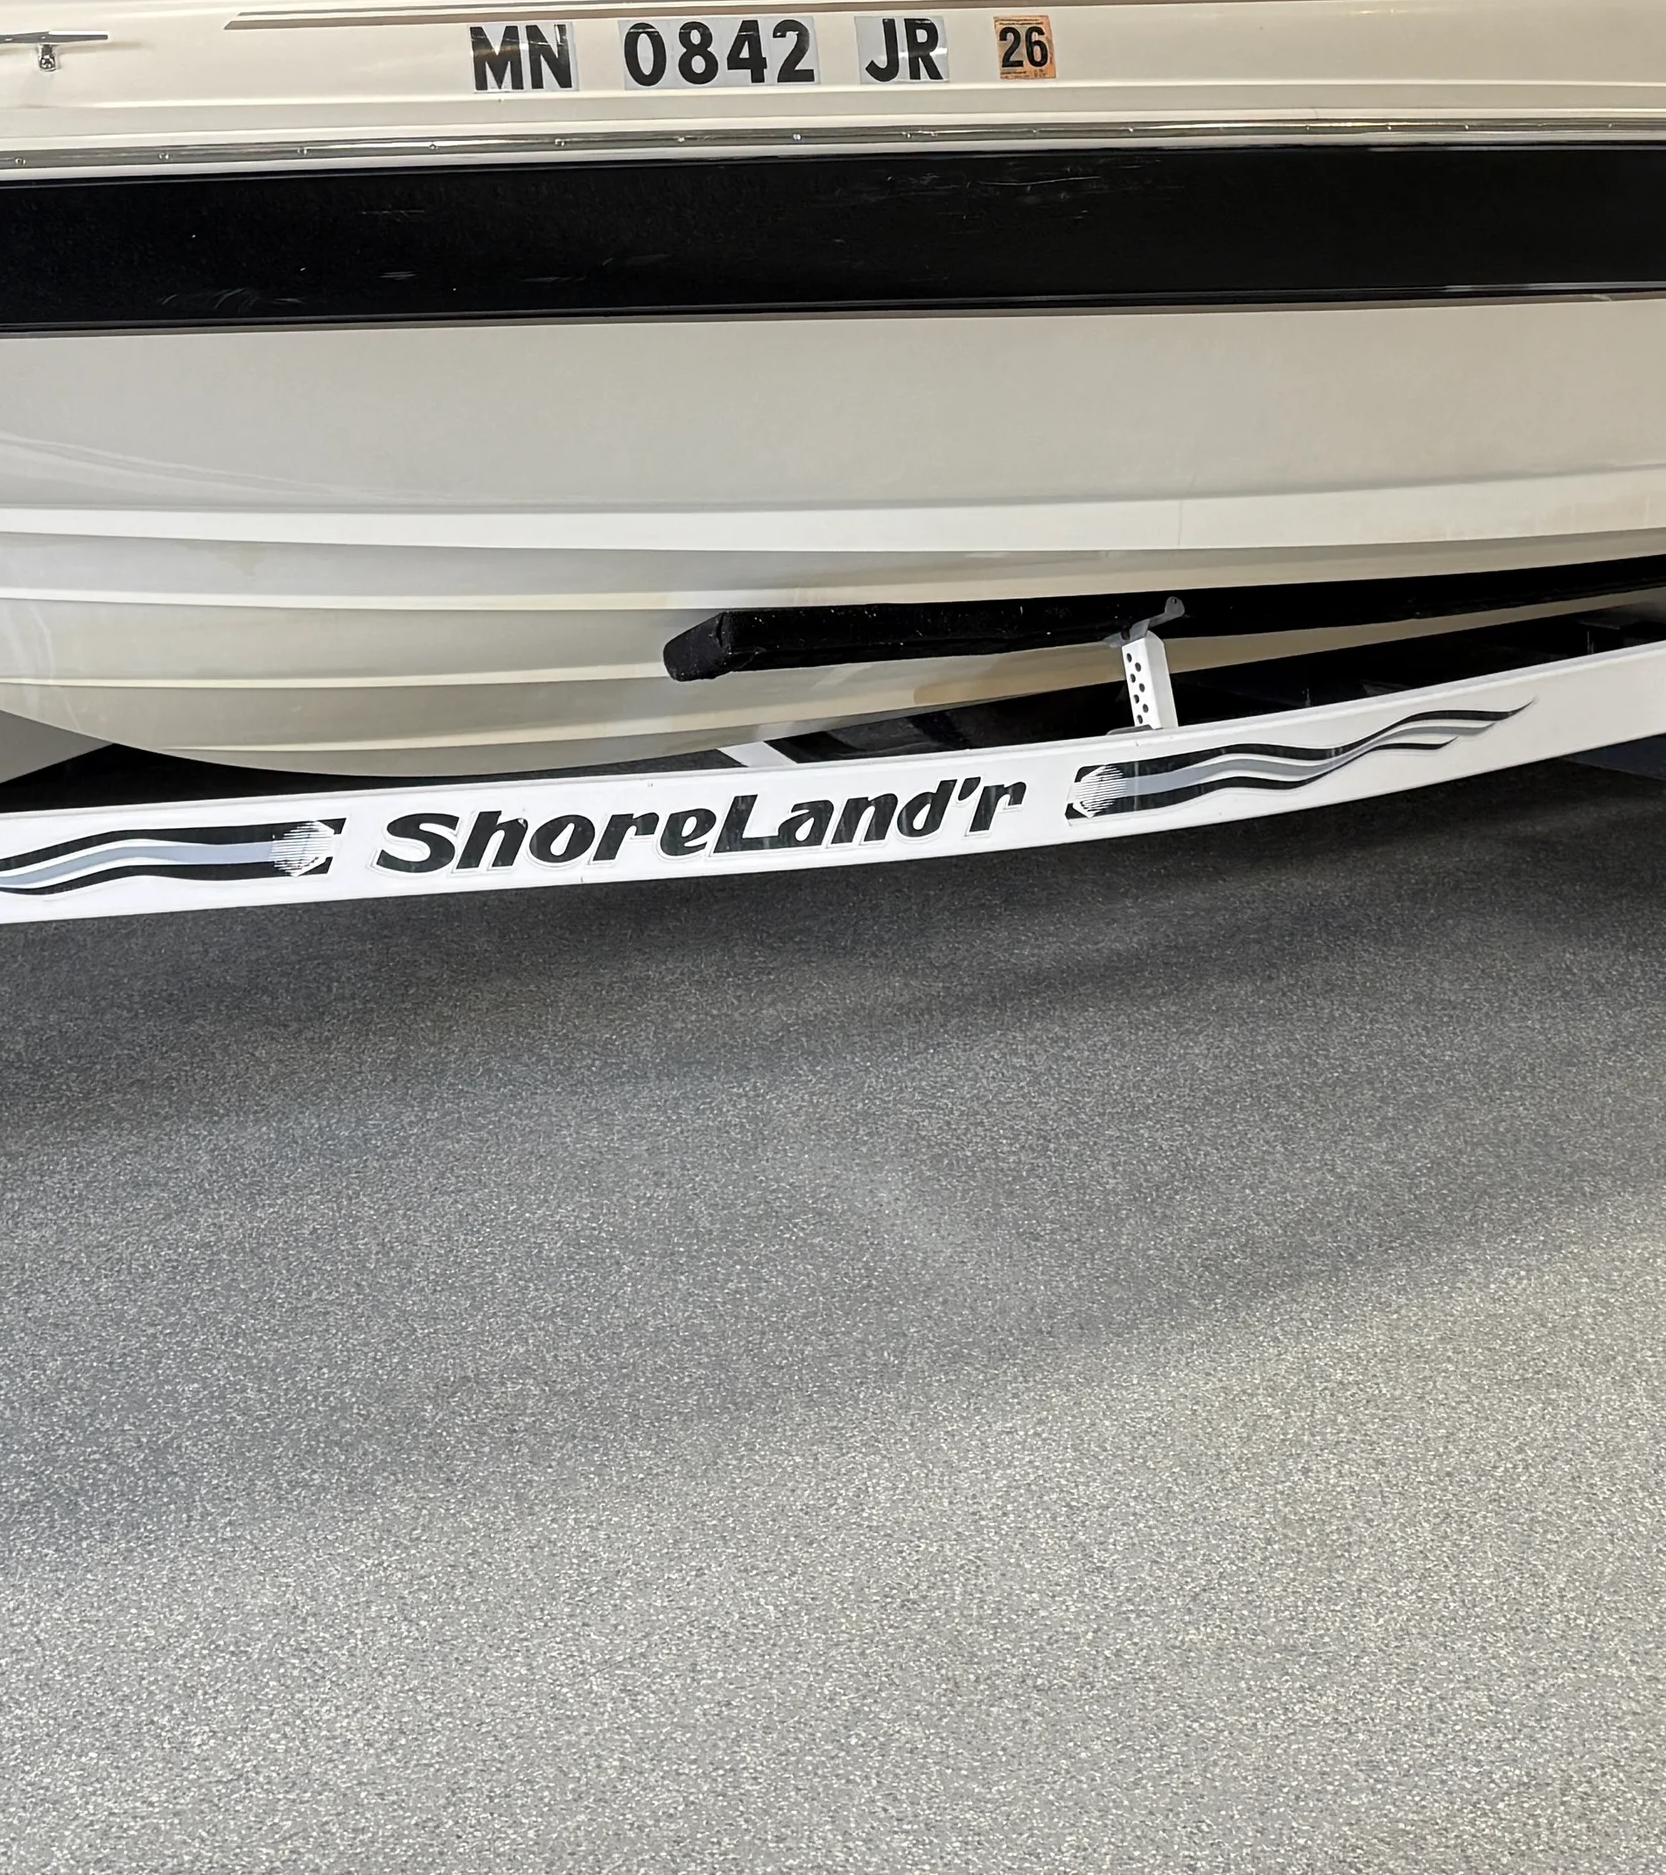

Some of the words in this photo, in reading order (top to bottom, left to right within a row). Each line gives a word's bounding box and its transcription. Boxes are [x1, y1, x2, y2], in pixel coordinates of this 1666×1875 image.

[470, 23, 575, 90] MN
[623, 18, 816, 86] 0842
[864, 17, 945, 82] JR
[999, 26, 1048, 67] 26
[375, 775, 1027, 874] ShoreLand'r
